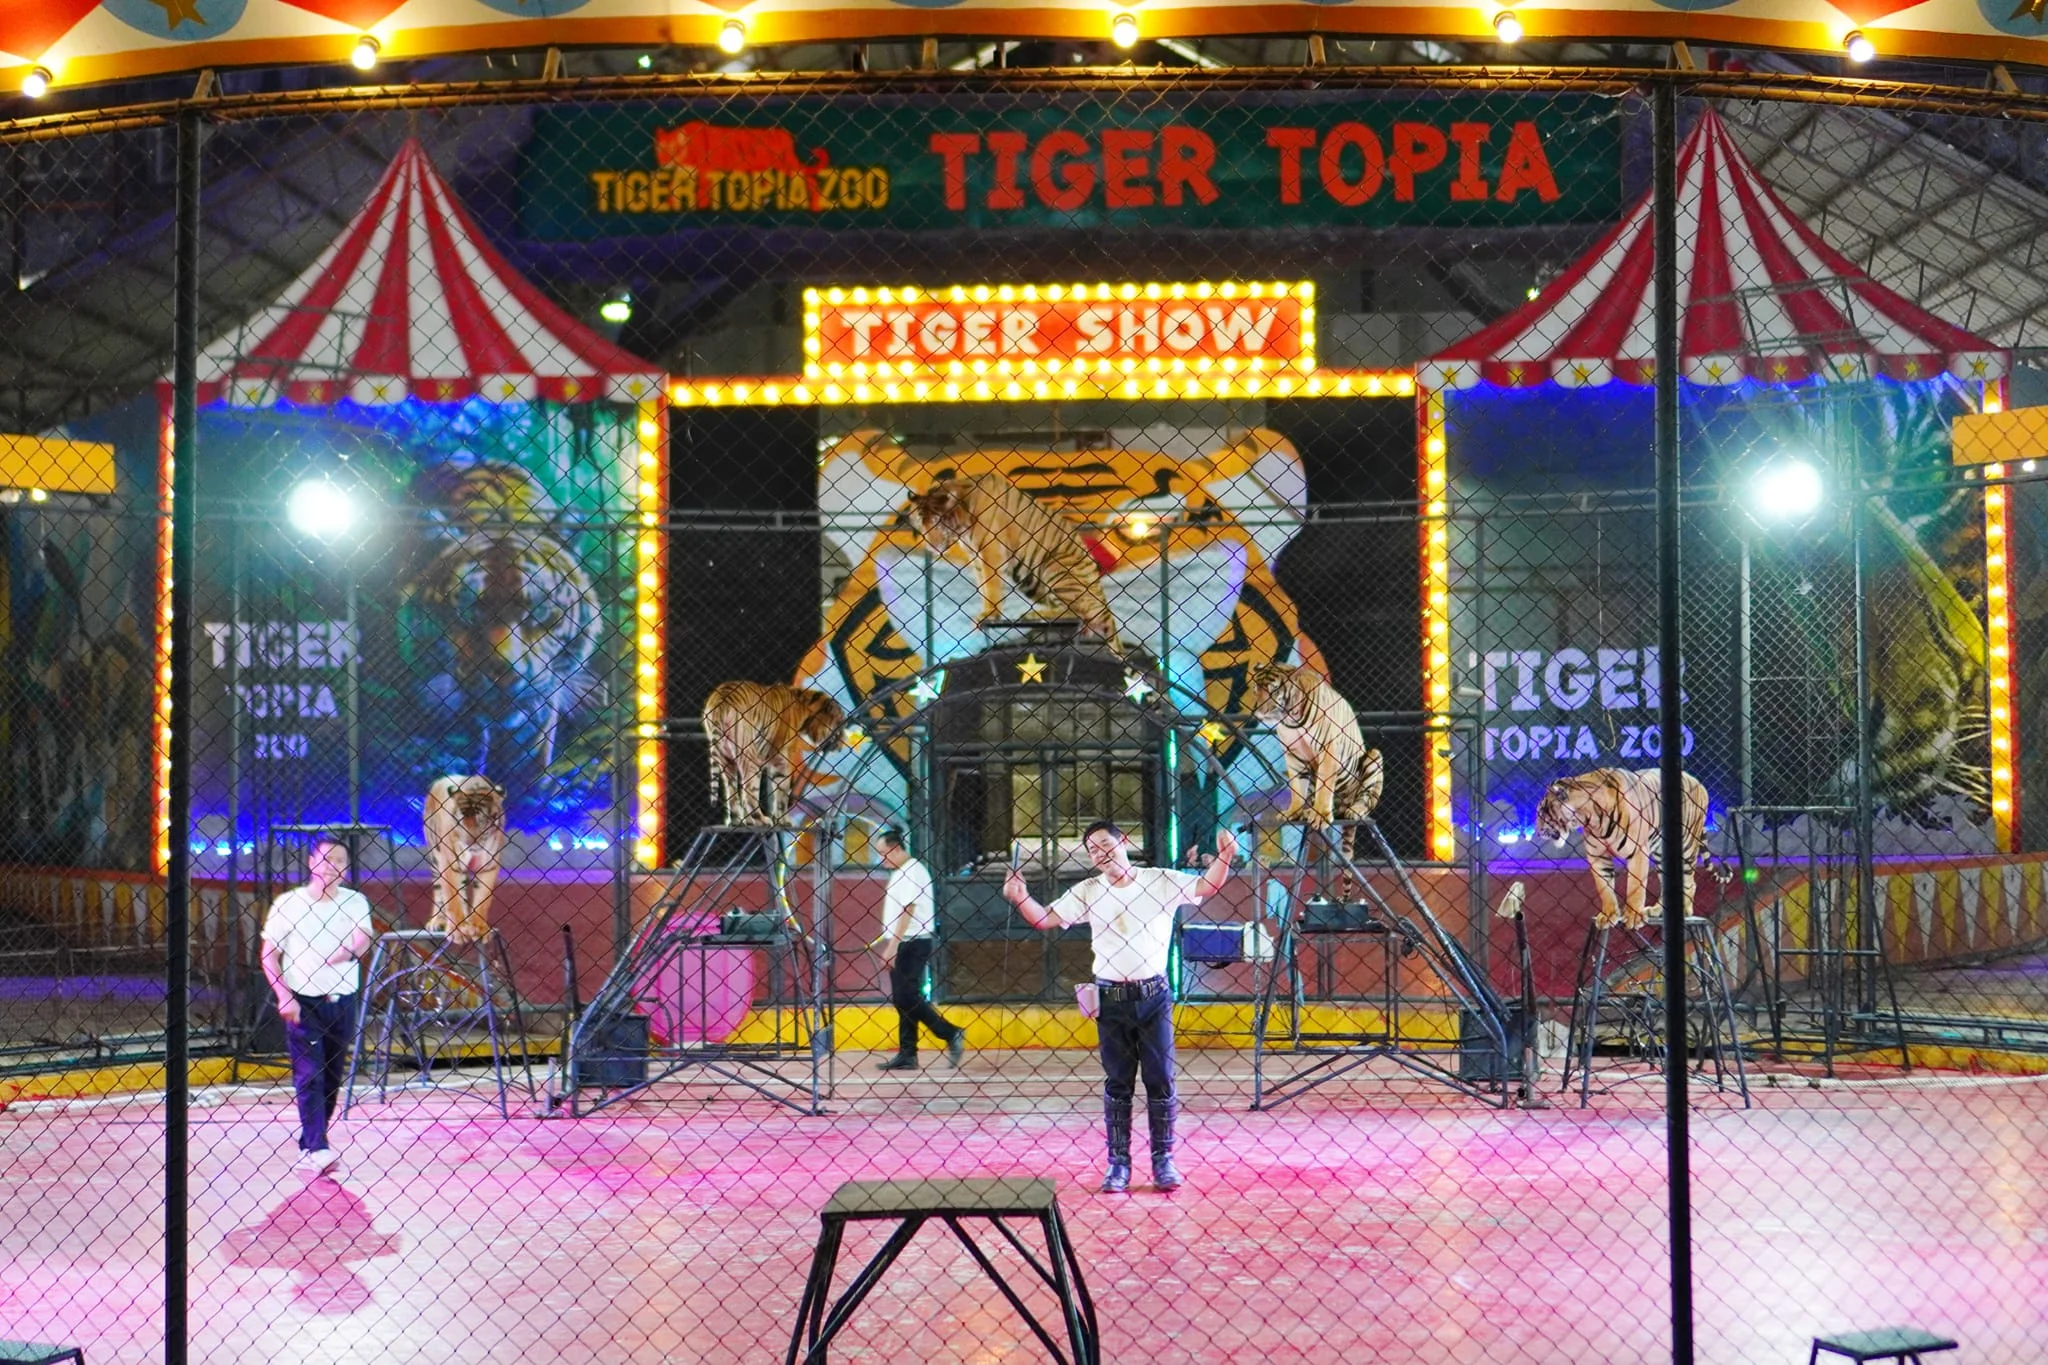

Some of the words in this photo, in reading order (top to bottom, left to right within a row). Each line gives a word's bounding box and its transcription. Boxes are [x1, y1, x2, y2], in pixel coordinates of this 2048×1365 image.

[591, 168, 697, 213] TIGER
[706, 167, 810, 212] TOPIA
[818, 166, 889, 210] ZOO
[930, 125, 1219, 211] TIGER
[1266, 120, 1561, 206] TOPIA
[842, 306, 1040, 357] TIGER
[1074, 306, 1278, 354] SHOW
[204, 621, 363, 669] TIGER
[1484, 725, 1600, 761] TOPIA
